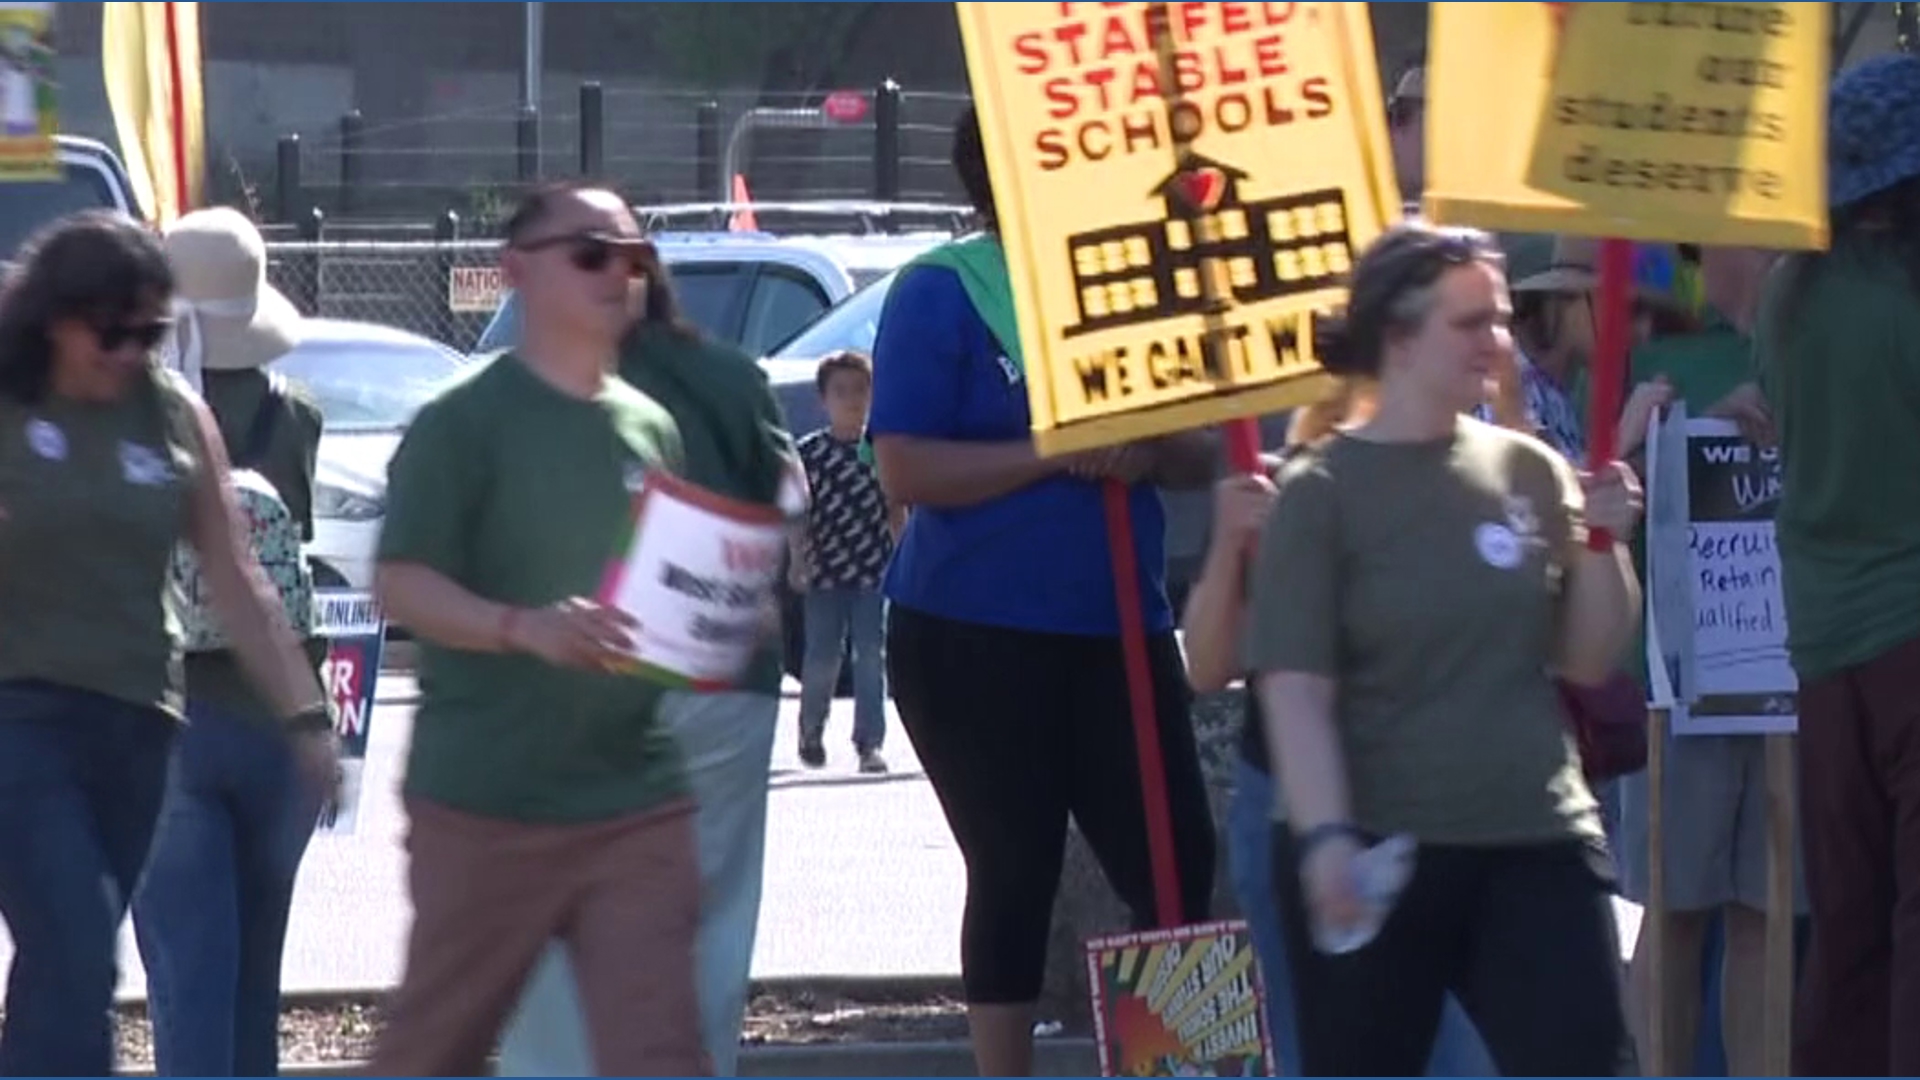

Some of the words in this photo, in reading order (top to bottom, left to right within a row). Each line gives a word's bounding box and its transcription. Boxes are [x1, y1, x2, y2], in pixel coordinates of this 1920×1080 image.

[1045, 35, 1288, 119] STABLE
[1035, 76, 1333, 169] SCHOOLS
[1564, 143, 1783, 200] deserve
[454, 271, 502, 291] NATIO
[1074, 347, 1133, 404] WE
[1702, 446, 1750, 463] WE
